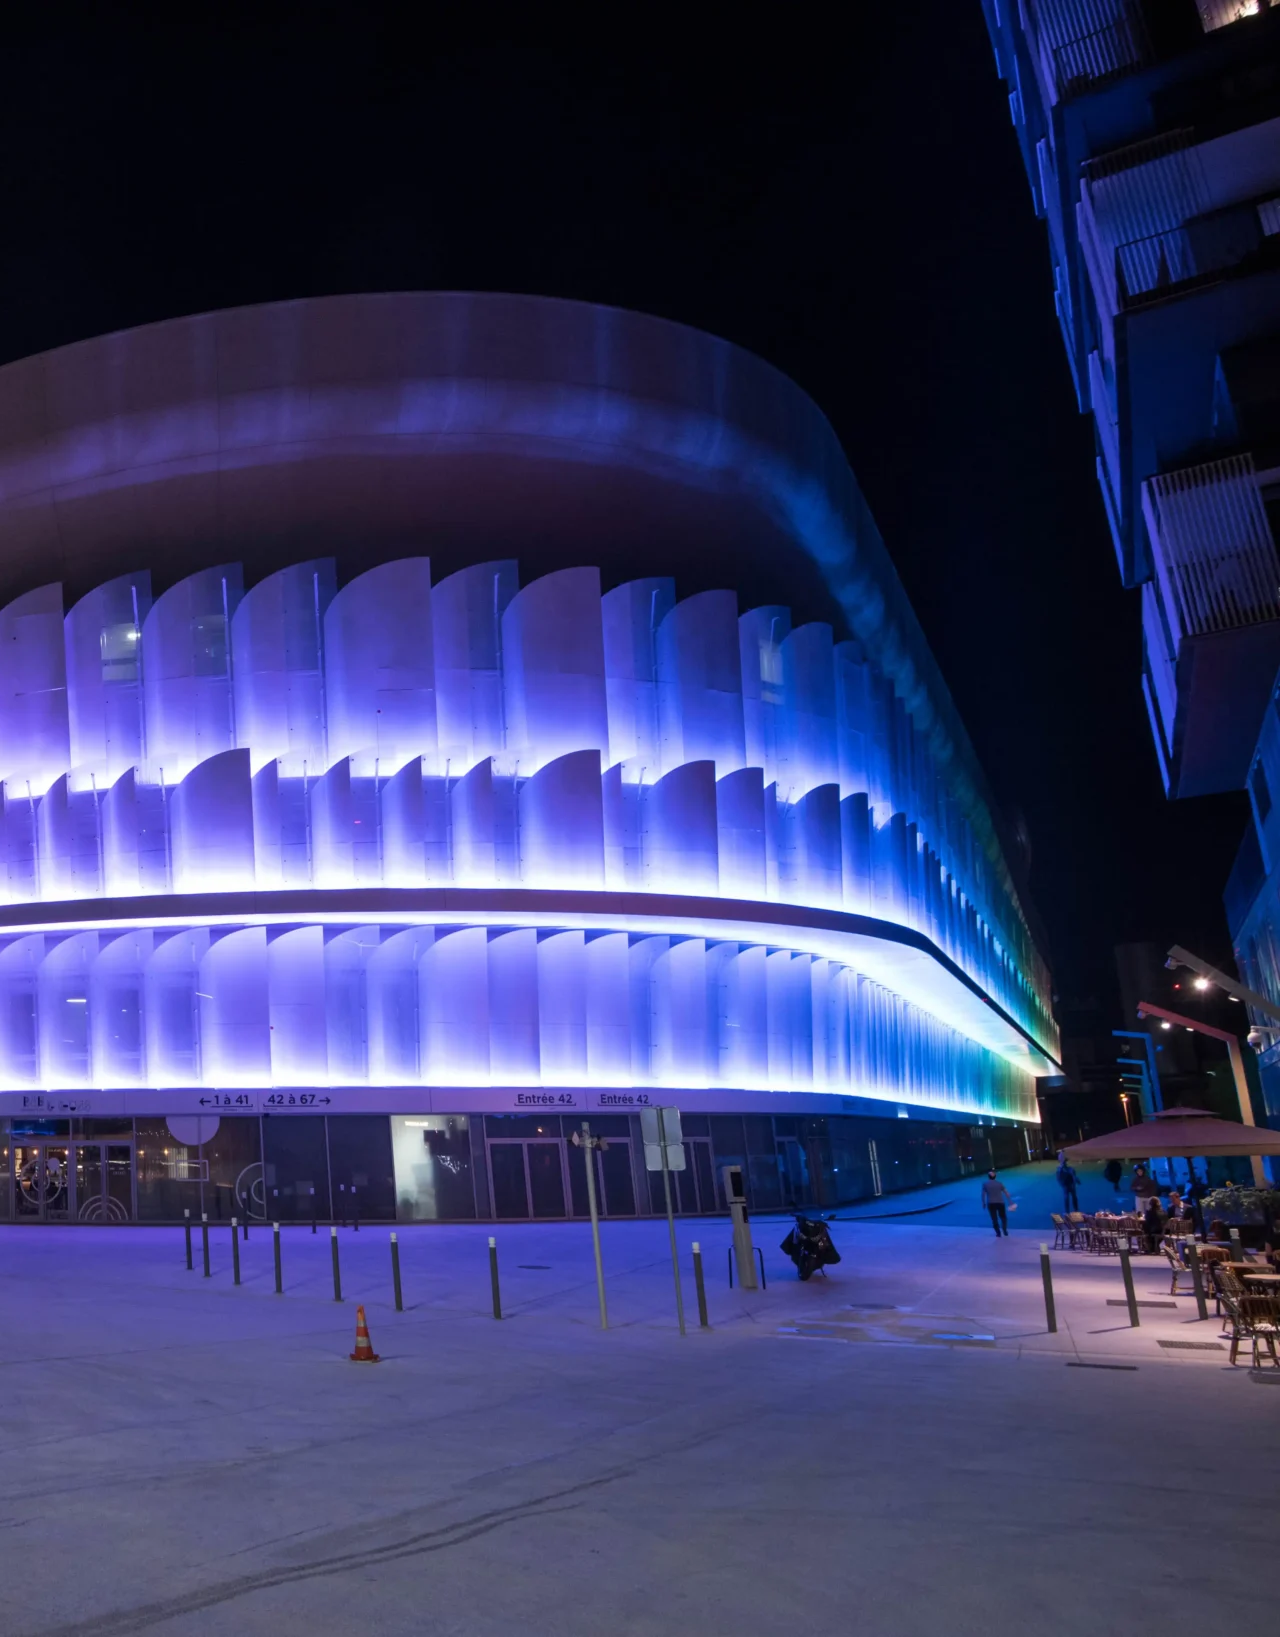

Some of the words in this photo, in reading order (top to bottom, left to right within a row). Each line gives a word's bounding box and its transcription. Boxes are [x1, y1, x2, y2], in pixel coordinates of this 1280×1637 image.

[223, 1093, 231, 1105] à
[235, 1095, 249, 1105] 41
[267, 1093, 285, 1105] 42
[288, 1093, 296, 1105] à
[299, 1094, 316, 1105] 67
[517, 1093, 555, 1104] Entrée
[558, 1093, 573, 1104] 42
[600, 1093, 634, 1105] Entrée
[636, 1094, 649, 1104] 42
